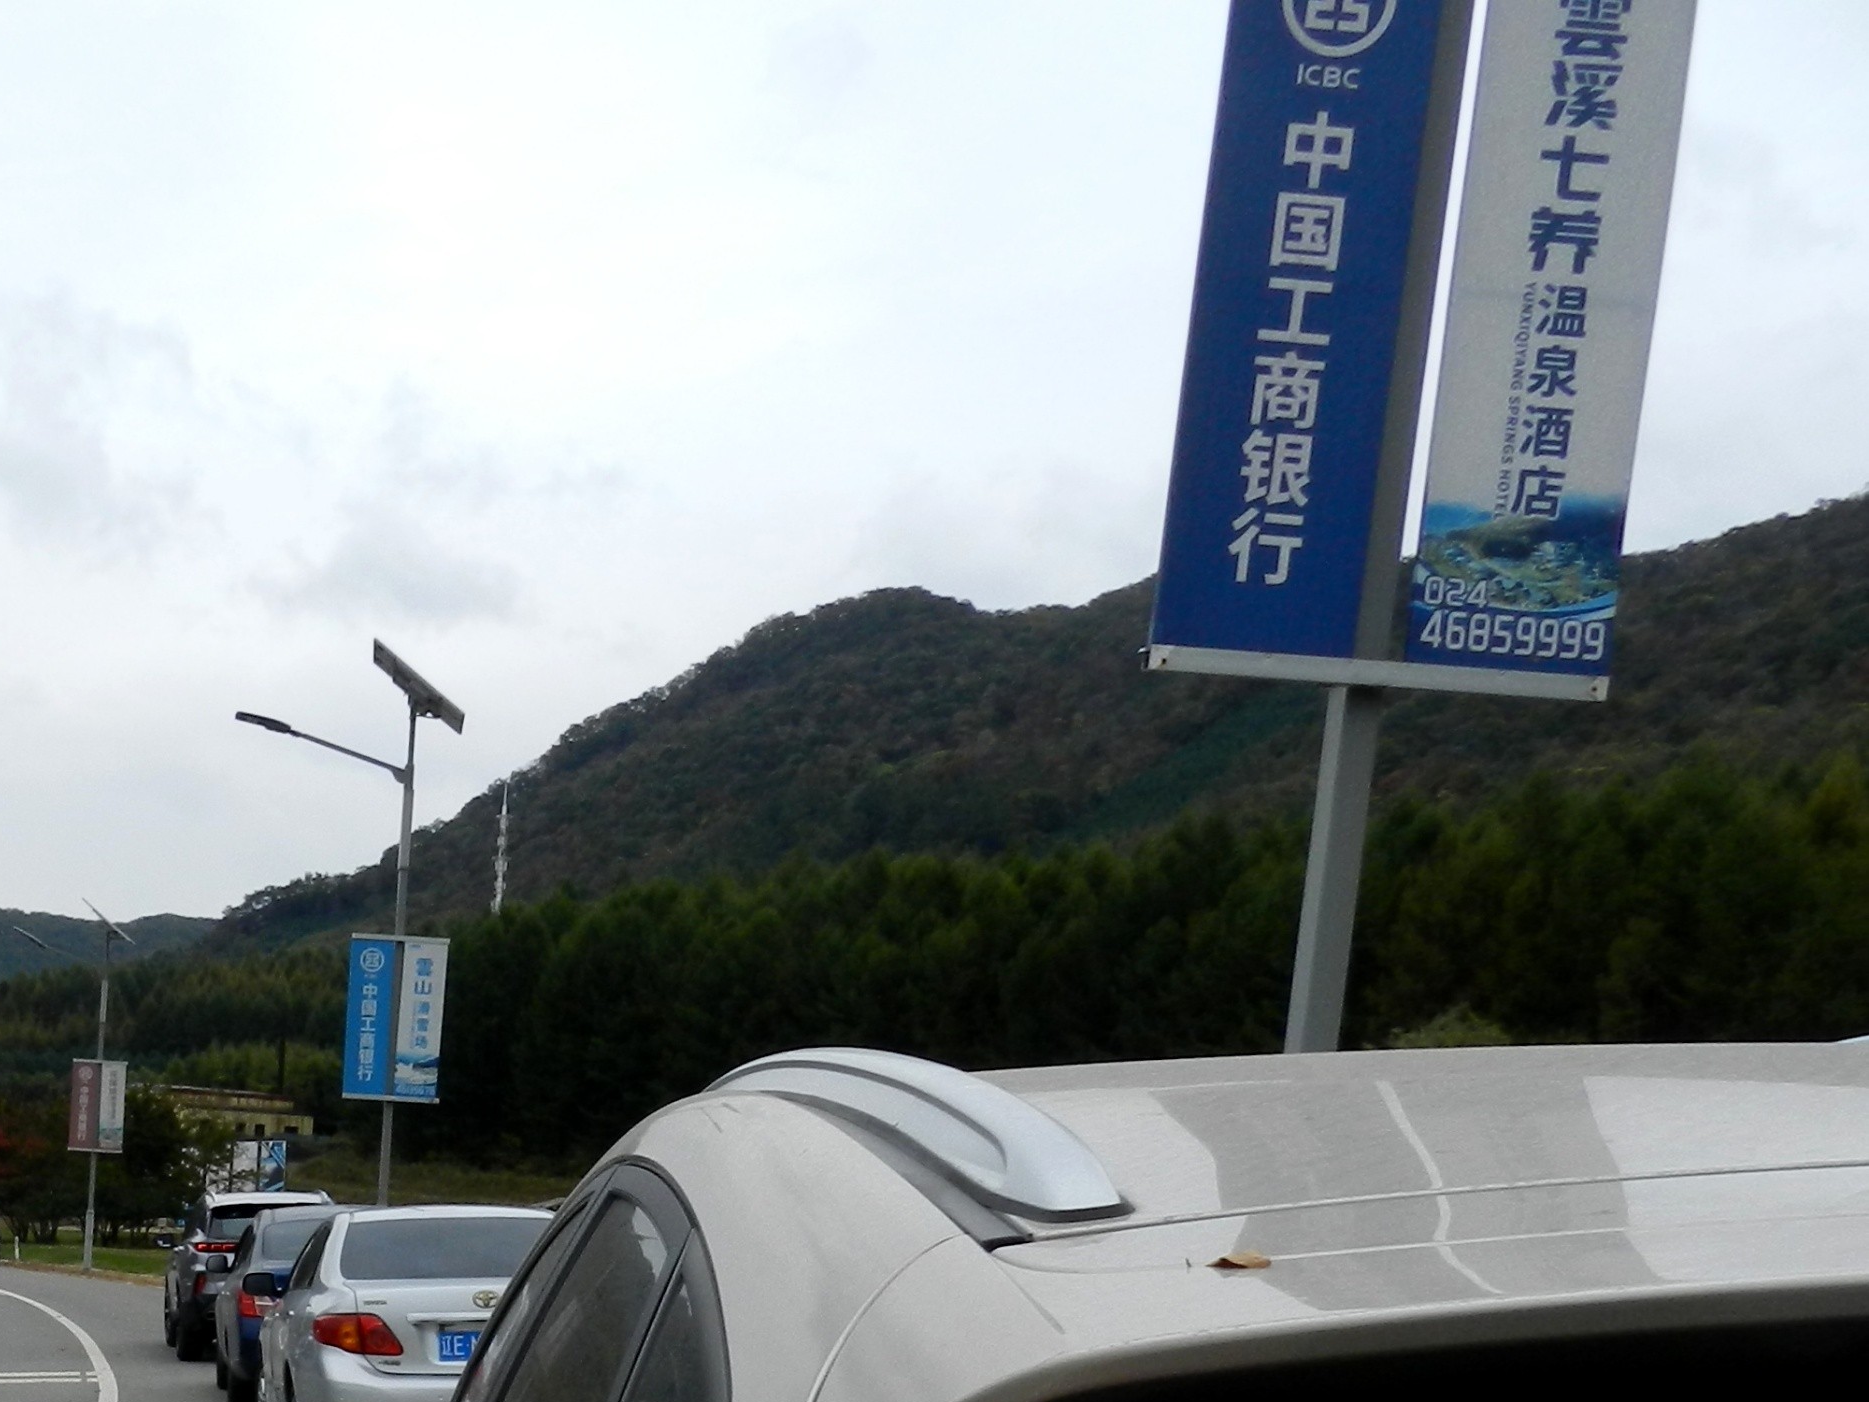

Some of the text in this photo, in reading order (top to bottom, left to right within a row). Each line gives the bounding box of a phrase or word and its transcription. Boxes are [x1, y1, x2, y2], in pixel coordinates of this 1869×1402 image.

[1296, 63, 1361, 90] ICBC
[1228, 110, 1355, 587] 中国工商银行
[1499, 395, 1523, 473] SPRINGS
[1424, 576, 1489, 608] 024
[1419, 609, 1606, 662] 46859999
